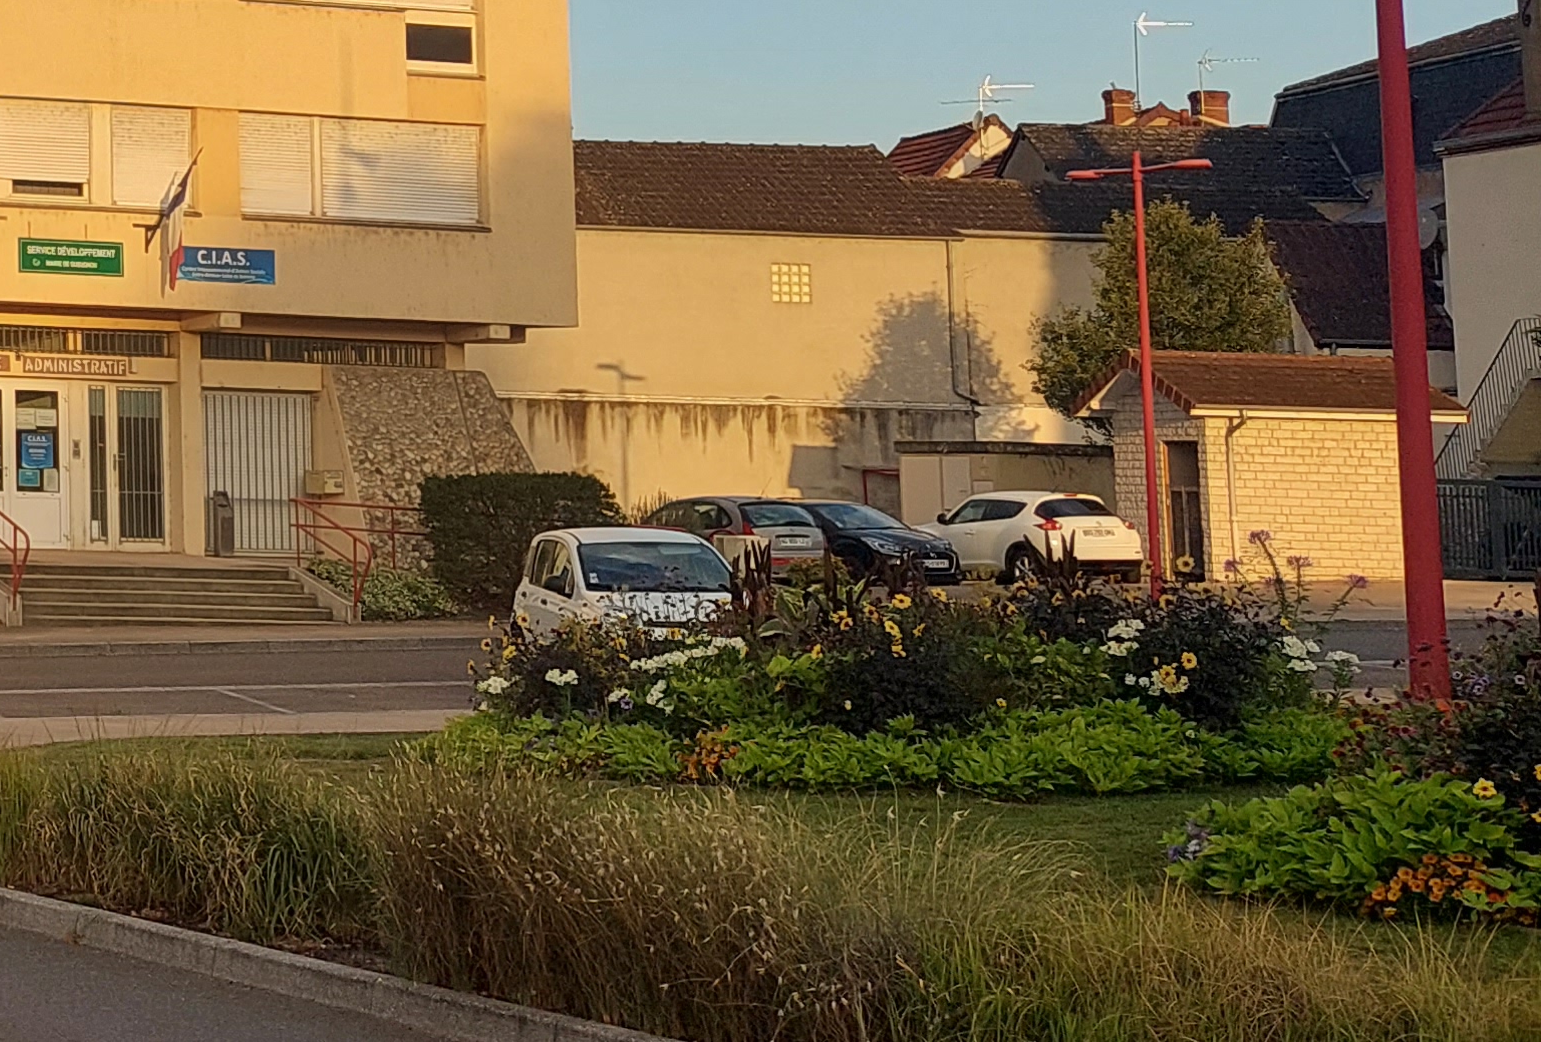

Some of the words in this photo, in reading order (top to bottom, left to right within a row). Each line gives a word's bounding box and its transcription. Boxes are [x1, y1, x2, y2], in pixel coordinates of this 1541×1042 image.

[27, 245, 57, 256] SERVICE
[57, 246, 116, 258] DÉVELOPPEMENT
[197, 250, 250, 266] C.I.A.S.
[25, 358, 126, 375] ADMINISTRATIF
